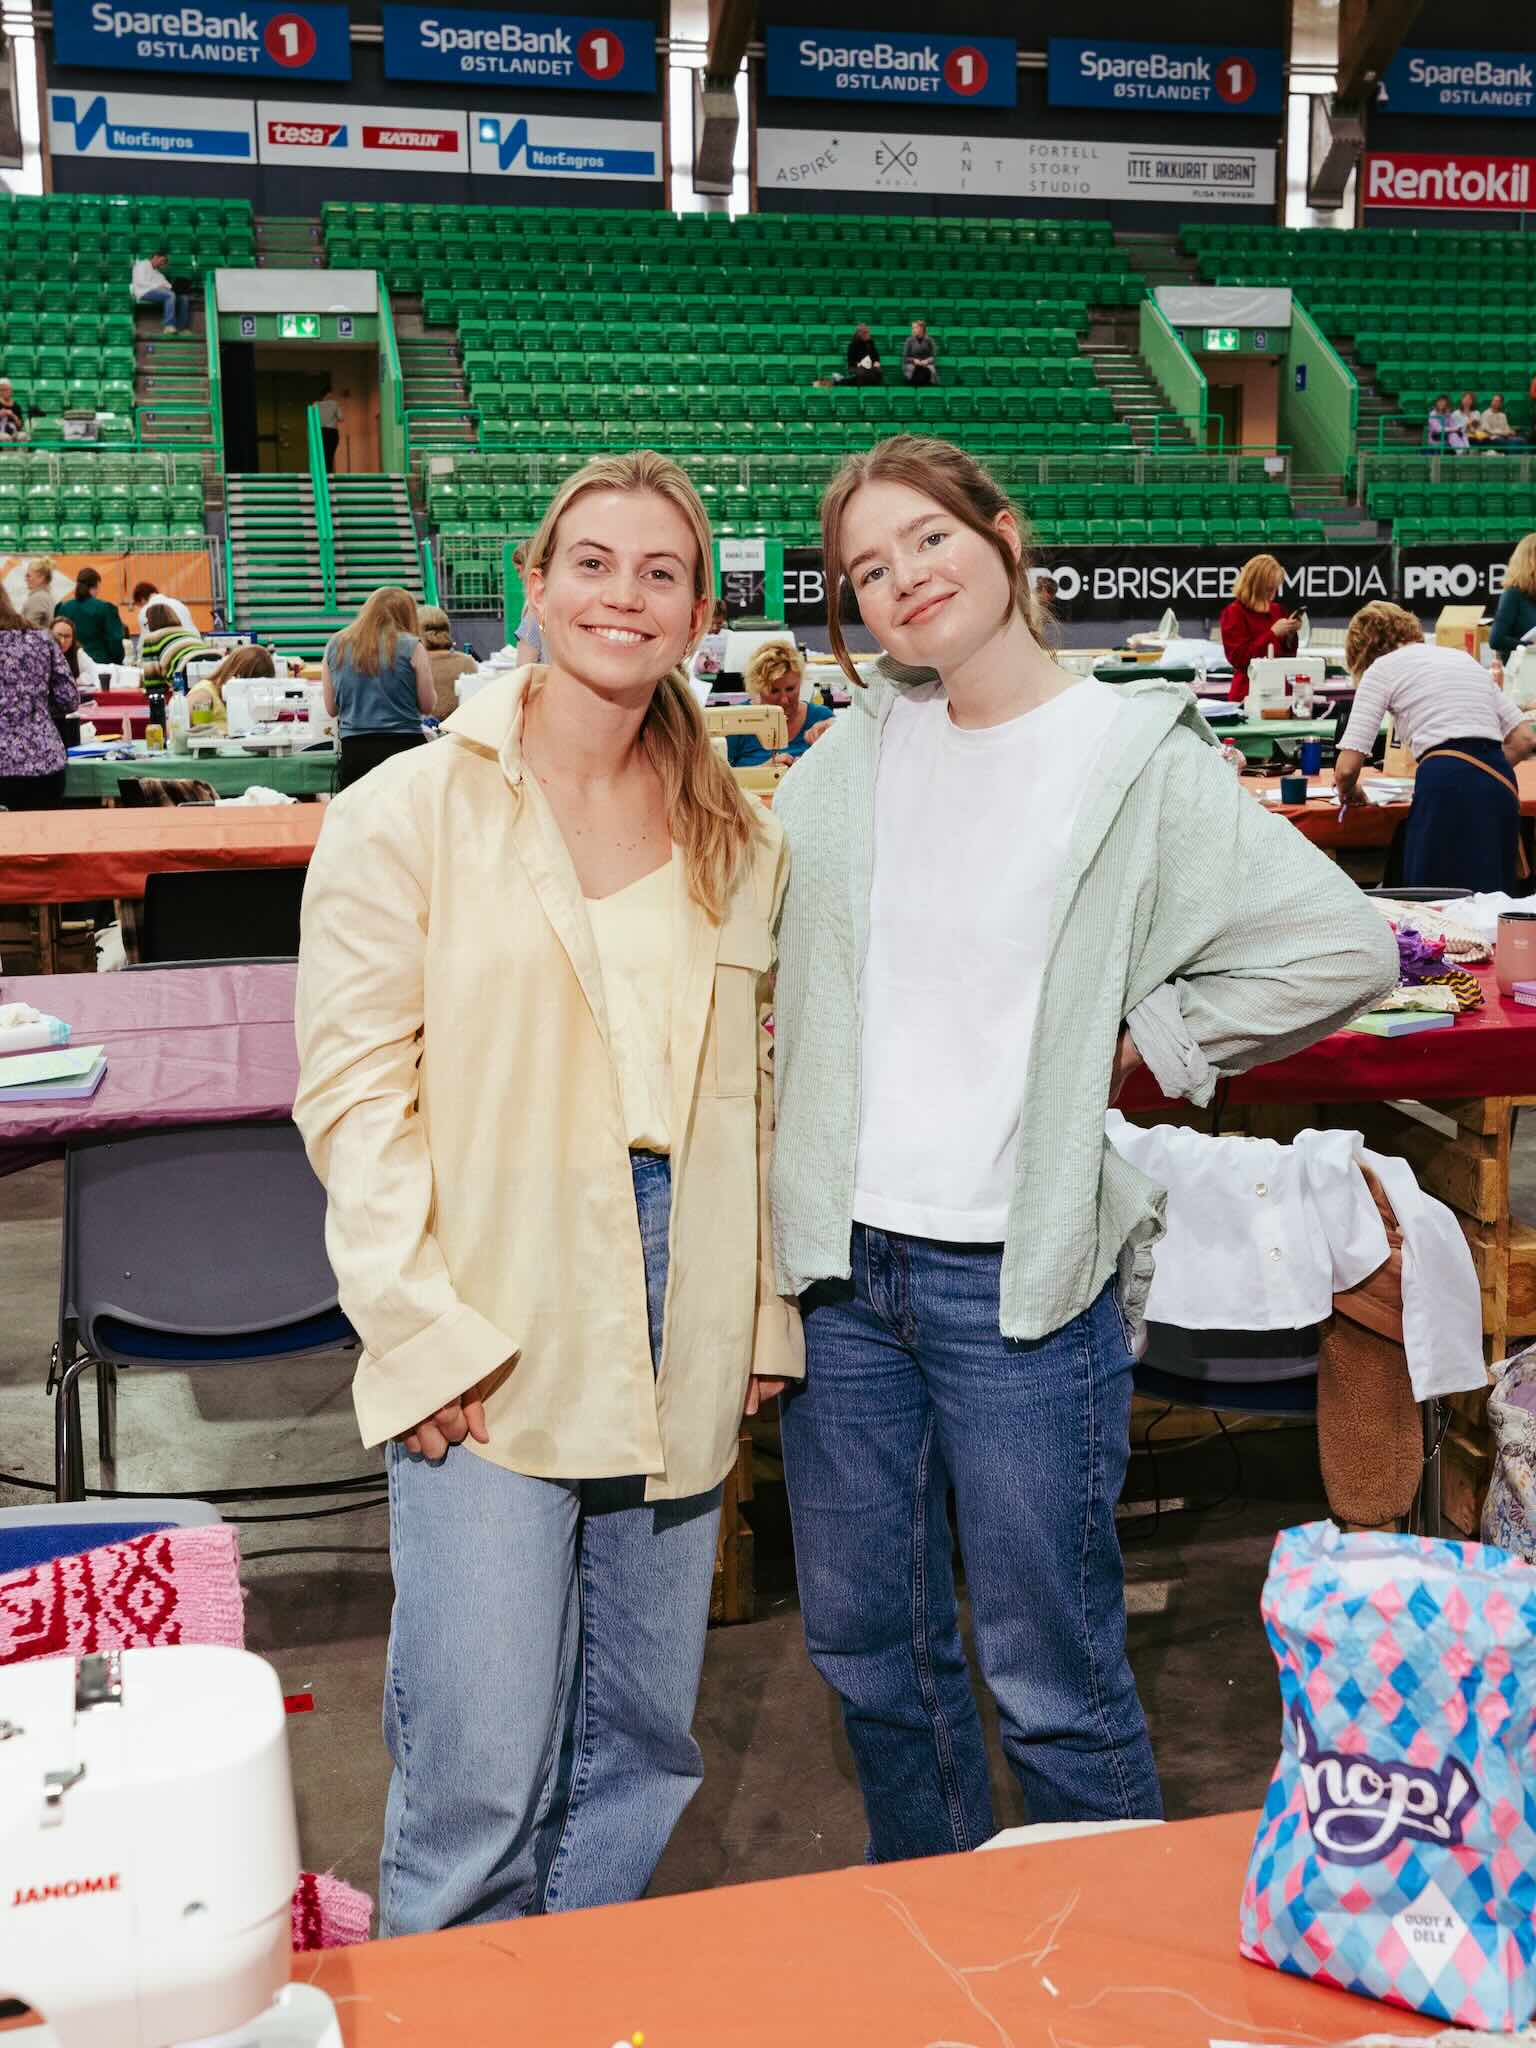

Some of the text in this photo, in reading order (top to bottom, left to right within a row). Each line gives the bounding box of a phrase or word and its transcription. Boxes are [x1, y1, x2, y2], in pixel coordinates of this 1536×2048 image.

[92, 3, 299, 57] SpareBank 1
[137, 41, 261, 63] ØSTLANDET
[419, 20, 608, 70] SpareBank 1
[460, 56, 574, 77] ØSTLANDET
[799, 40, 974, 86] SpareBank 1
[1080, 50, 1242, 95] SpareBank 1
[1409, 58, 1534, 88] SpareBank
[835, 73, 941, 93] ØSTLANDET
[1112, 82, 1211, 101] ØSTLANDET
[1439, 88, 1534, 107] ØSTLANDET
[113, 130, 194, 150] NorEngros
[271, 123, 325, 144] tesa
[377, 131, 440, 148] KATRIN
[532, 150, 605, 169] NorEngros
[1029, 144, 1100, 160] FORTELL
[775, 149, 838, 183] ASPIRE
[1029, 162, 1081, 176] STORY
[1155, 160, 1208, 181] AKKURAT
[1029, 180, 1091, 194] STUDIO
[1368, 159, 1530, 203] Rentokil
[1277, 565, 1388, 598] MEDIA
[12, 1873, 120, 1907] JANOME
